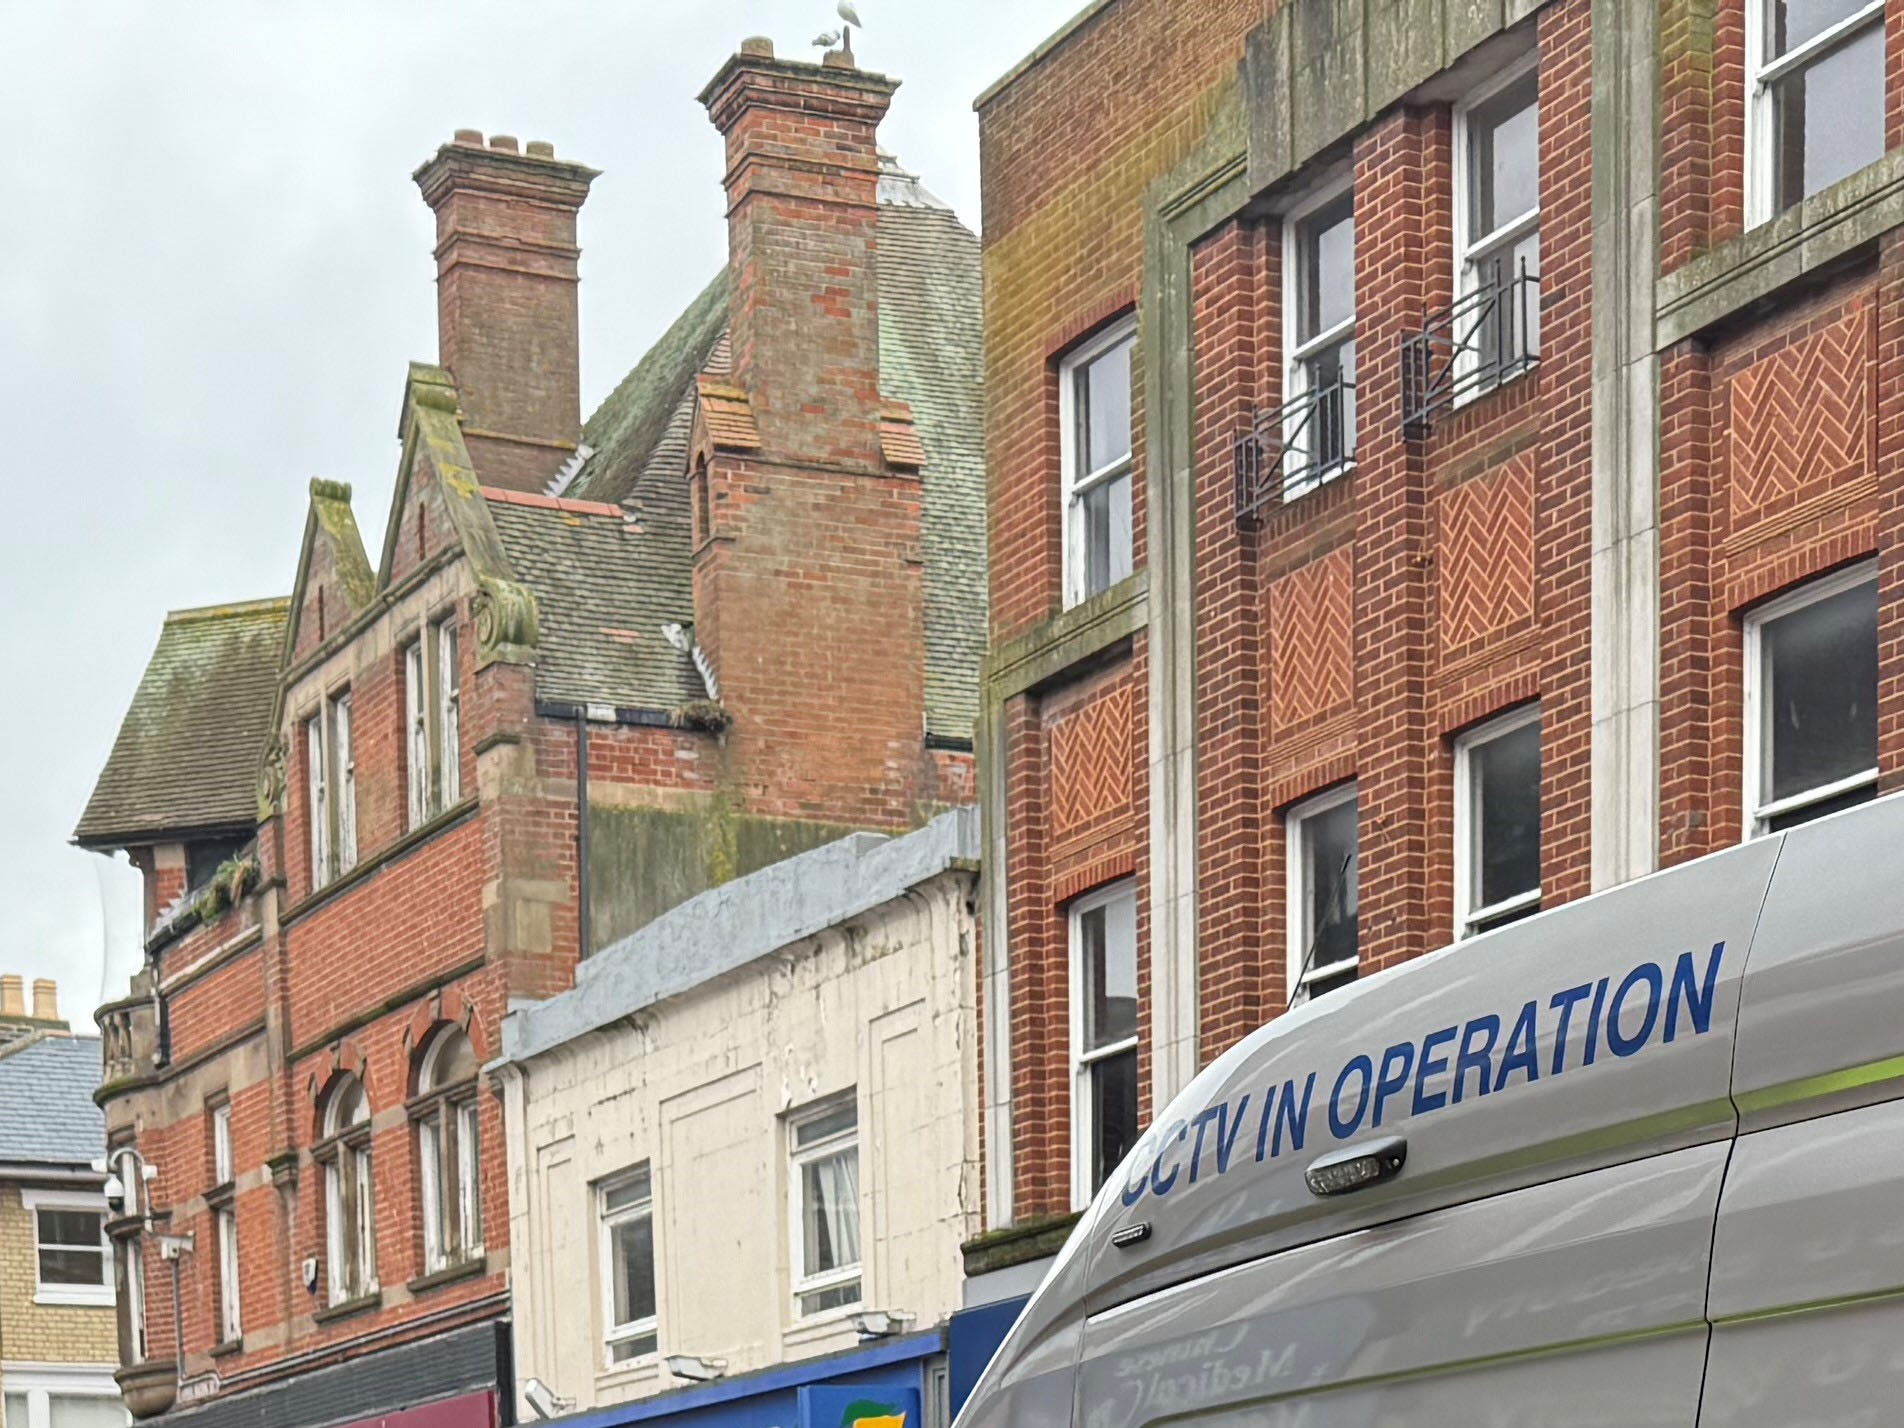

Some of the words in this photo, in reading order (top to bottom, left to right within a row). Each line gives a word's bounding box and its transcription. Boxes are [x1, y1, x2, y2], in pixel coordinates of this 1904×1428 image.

[1122, 1095, 1251, 1207] CCTV
[1255, 1070, 1317, 1162] IN
[1327, 940, 1726, 1140] OPERATION
